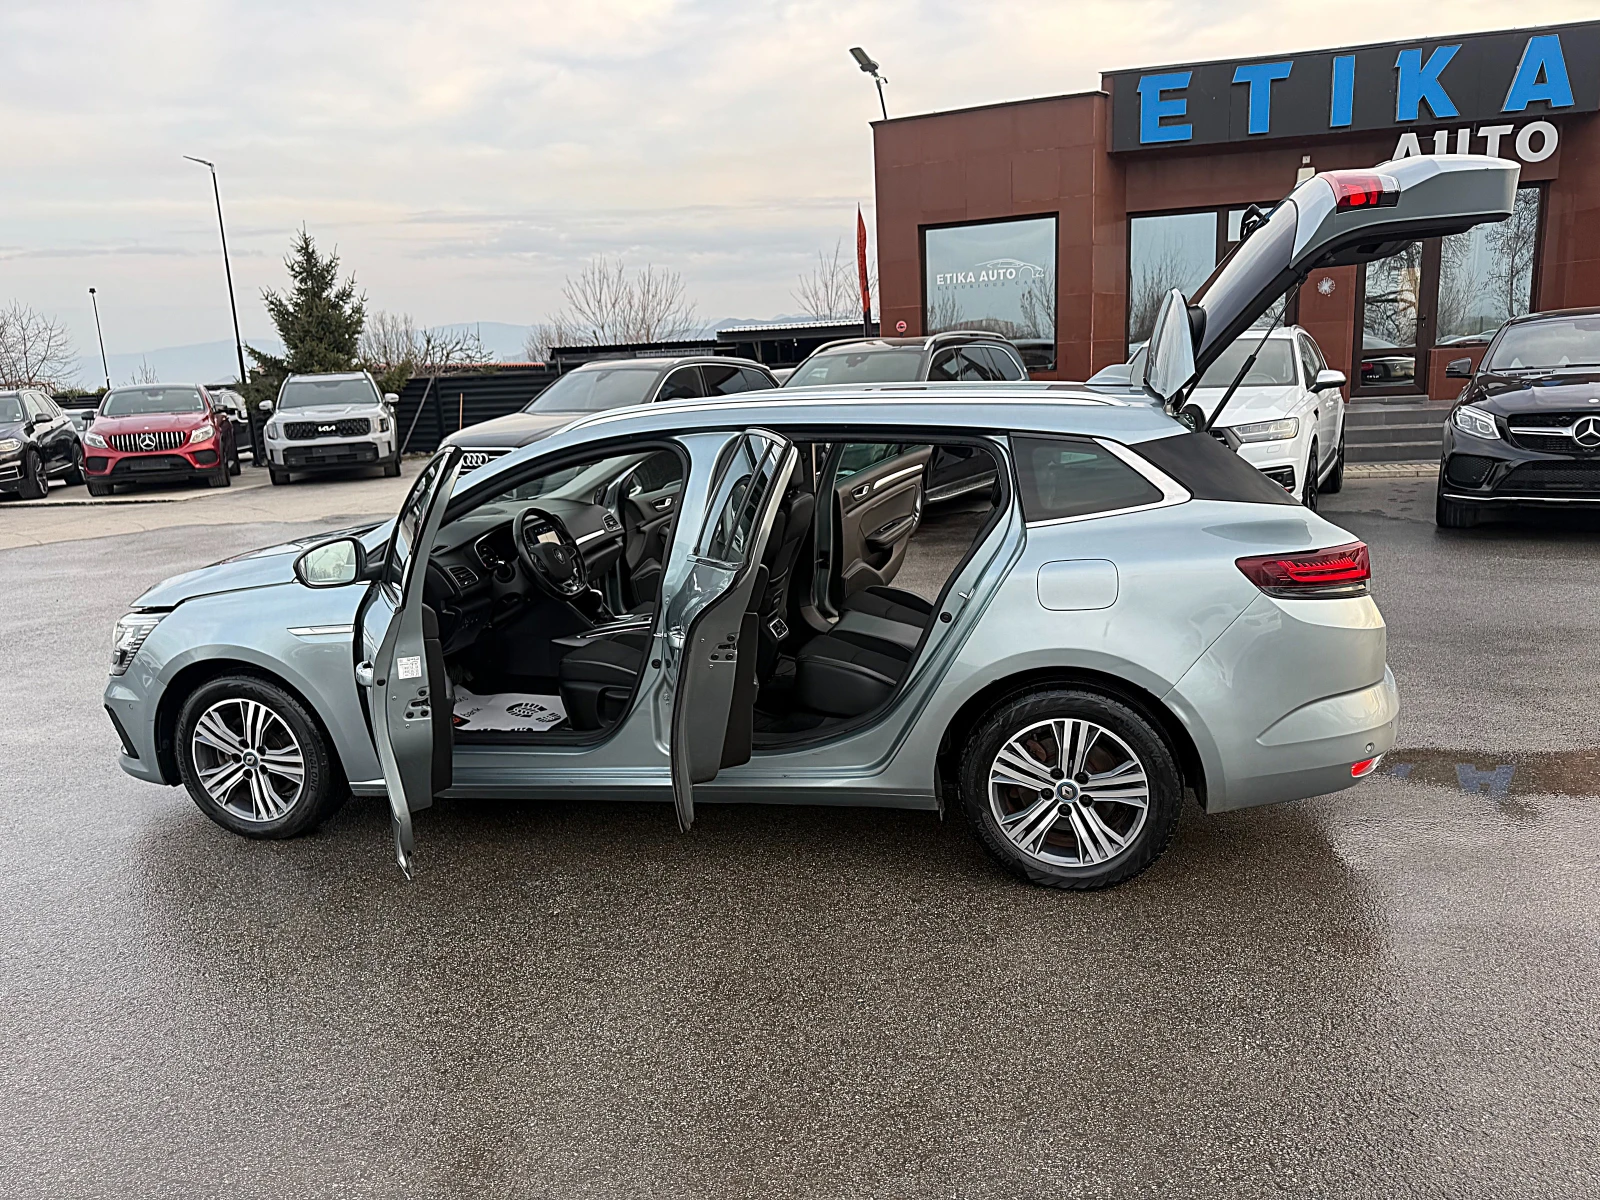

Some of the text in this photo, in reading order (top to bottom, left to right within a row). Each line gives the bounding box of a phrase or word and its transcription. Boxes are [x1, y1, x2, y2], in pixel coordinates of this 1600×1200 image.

[1136, 33, 1575, 145] ETIKA
[1391, 120, 1559, 163] AUTO
[936, 268, 1016, 285] ETIKA AUTO
[937, 281, 1006, 291] LUXURIOUS
[304, 741, 318, 792] LINGLONG
[974, 819, 1013, 866] UNIROYAL
